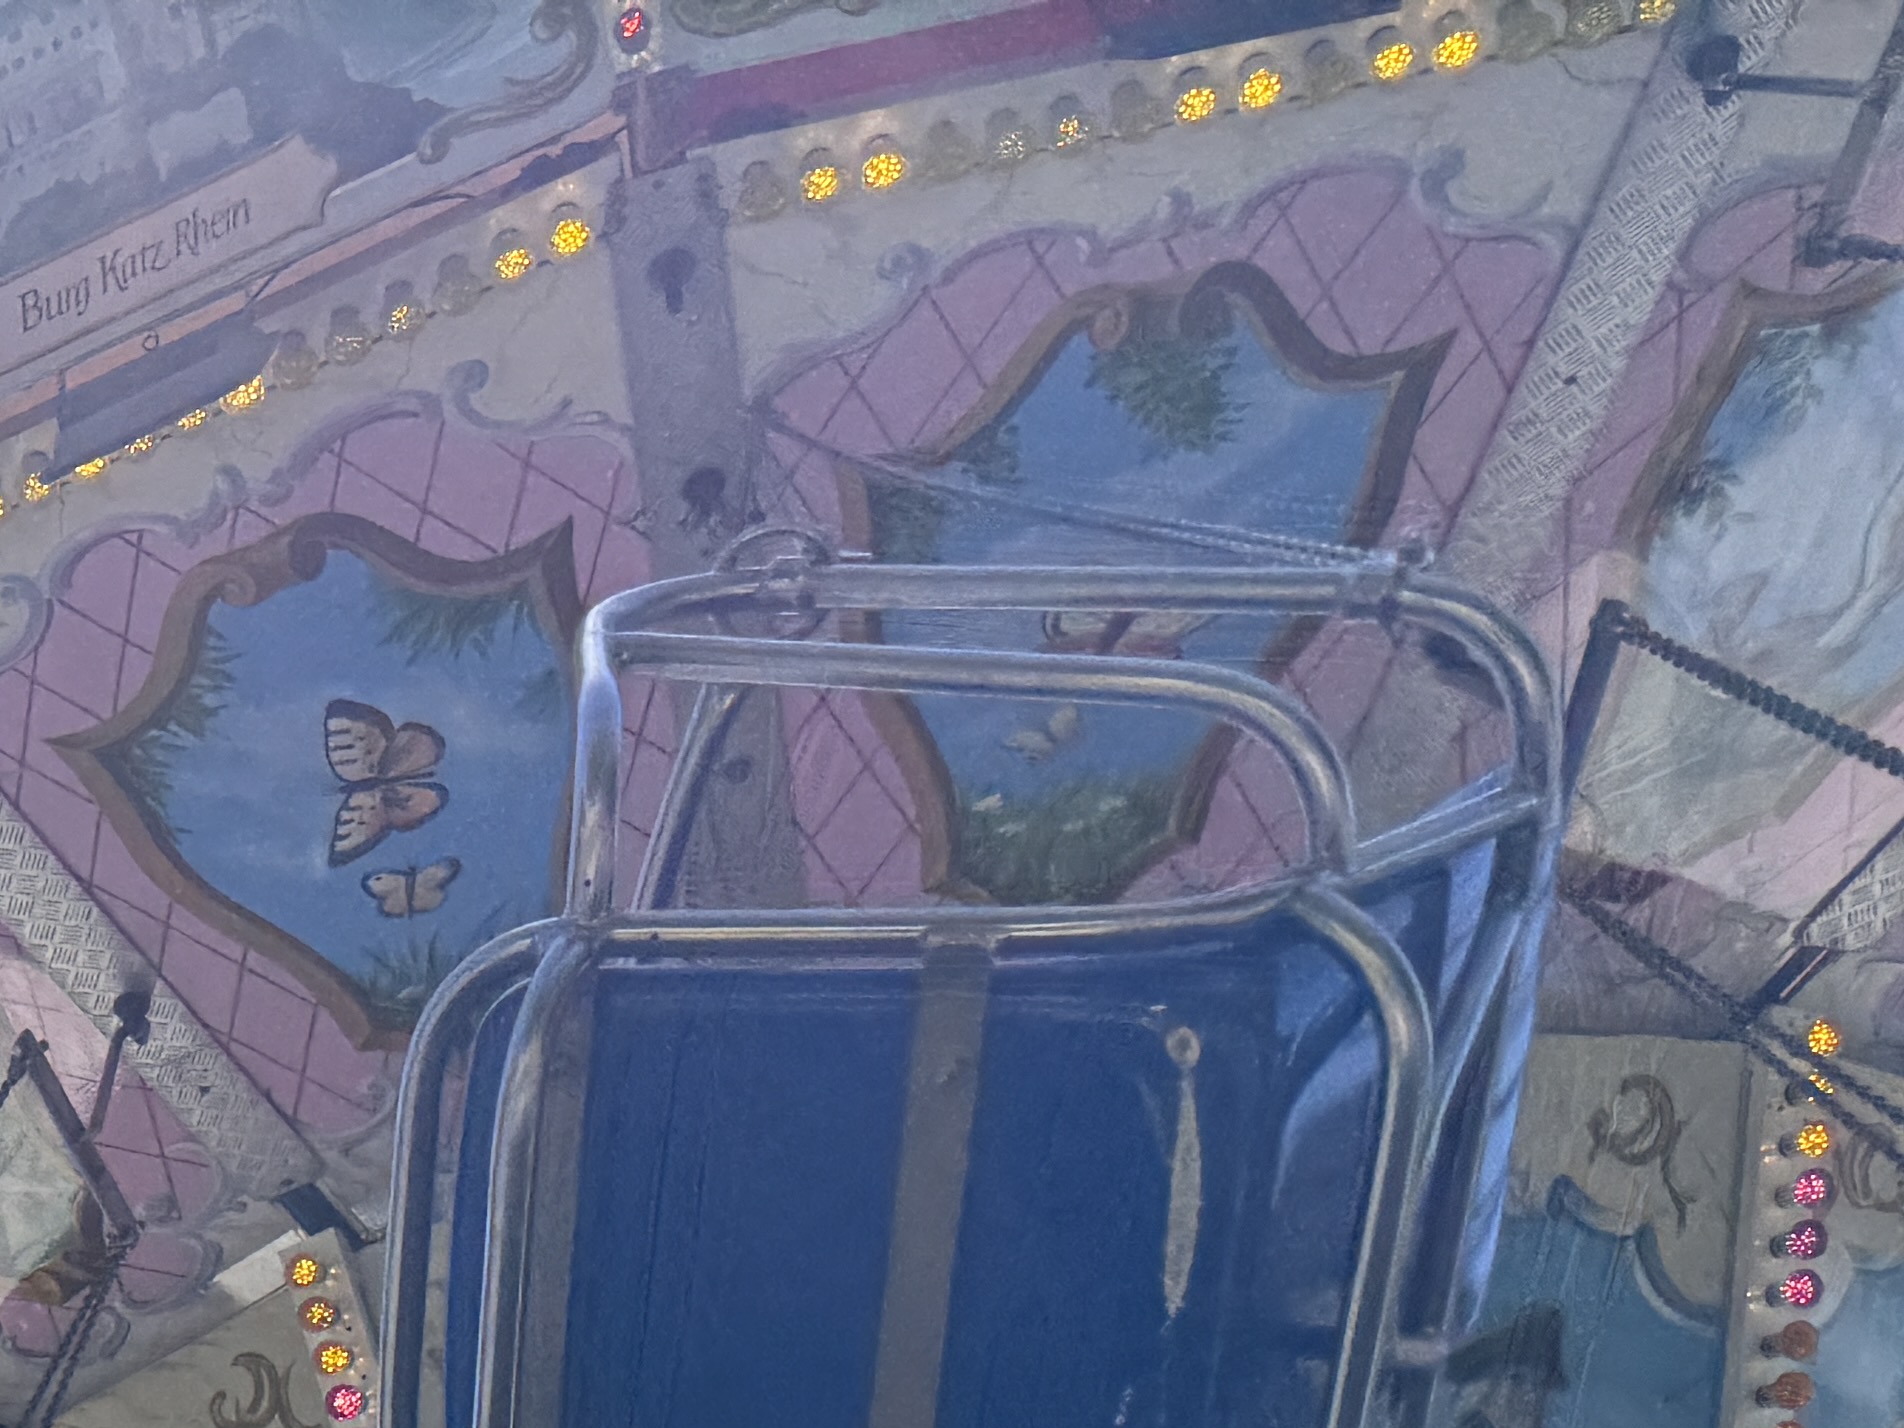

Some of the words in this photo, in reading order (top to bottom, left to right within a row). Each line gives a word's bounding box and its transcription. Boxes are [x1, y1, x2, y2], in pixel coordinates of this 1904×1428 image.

[17, 277, 92, 333] Burg
[97, 240, 173, 295] Katz
[174, 198, 252, 258] Rhein
